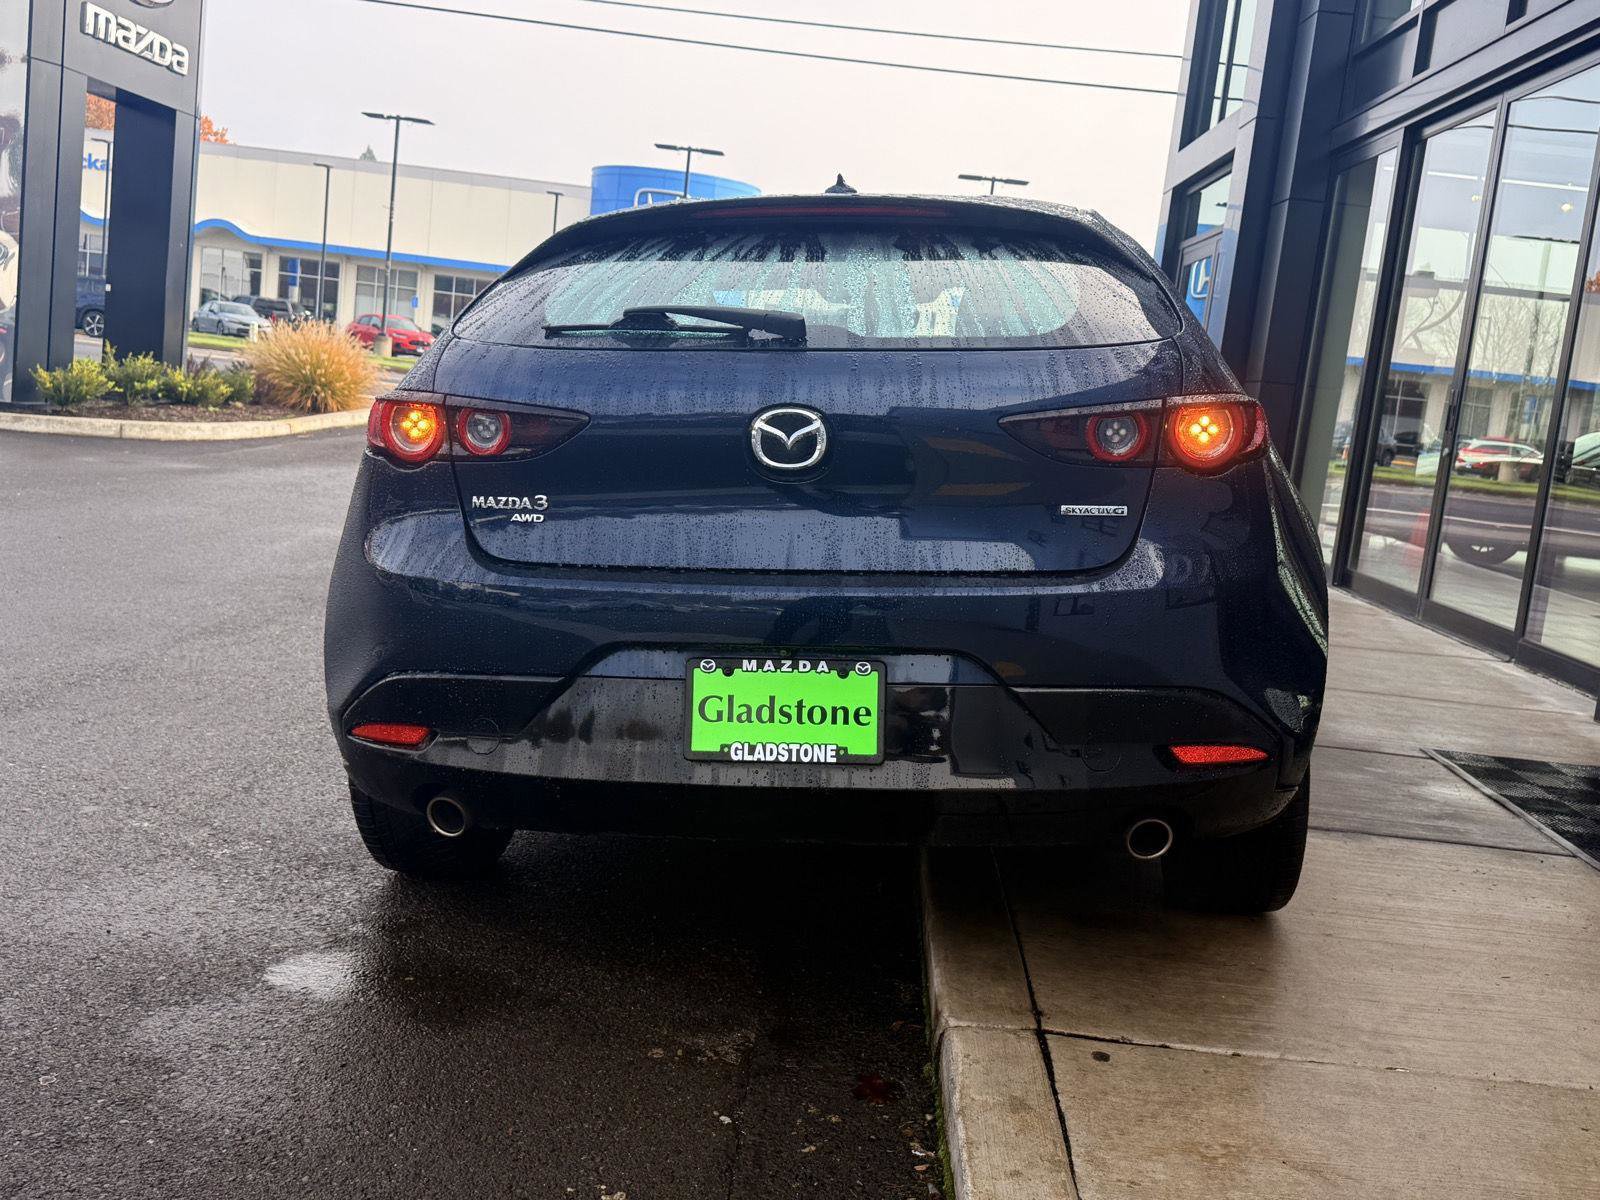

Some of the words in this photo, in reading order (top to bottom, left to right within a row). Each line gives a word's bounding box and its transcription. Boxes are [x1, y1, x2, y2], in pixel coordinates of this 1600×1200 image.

[510, 513, 545, 523] AWD
[742, 659, 829, 673] MAZDA
[697, 694, 872, 726] Gladstone
[730, 742, 837, 763] GLADSTONE
